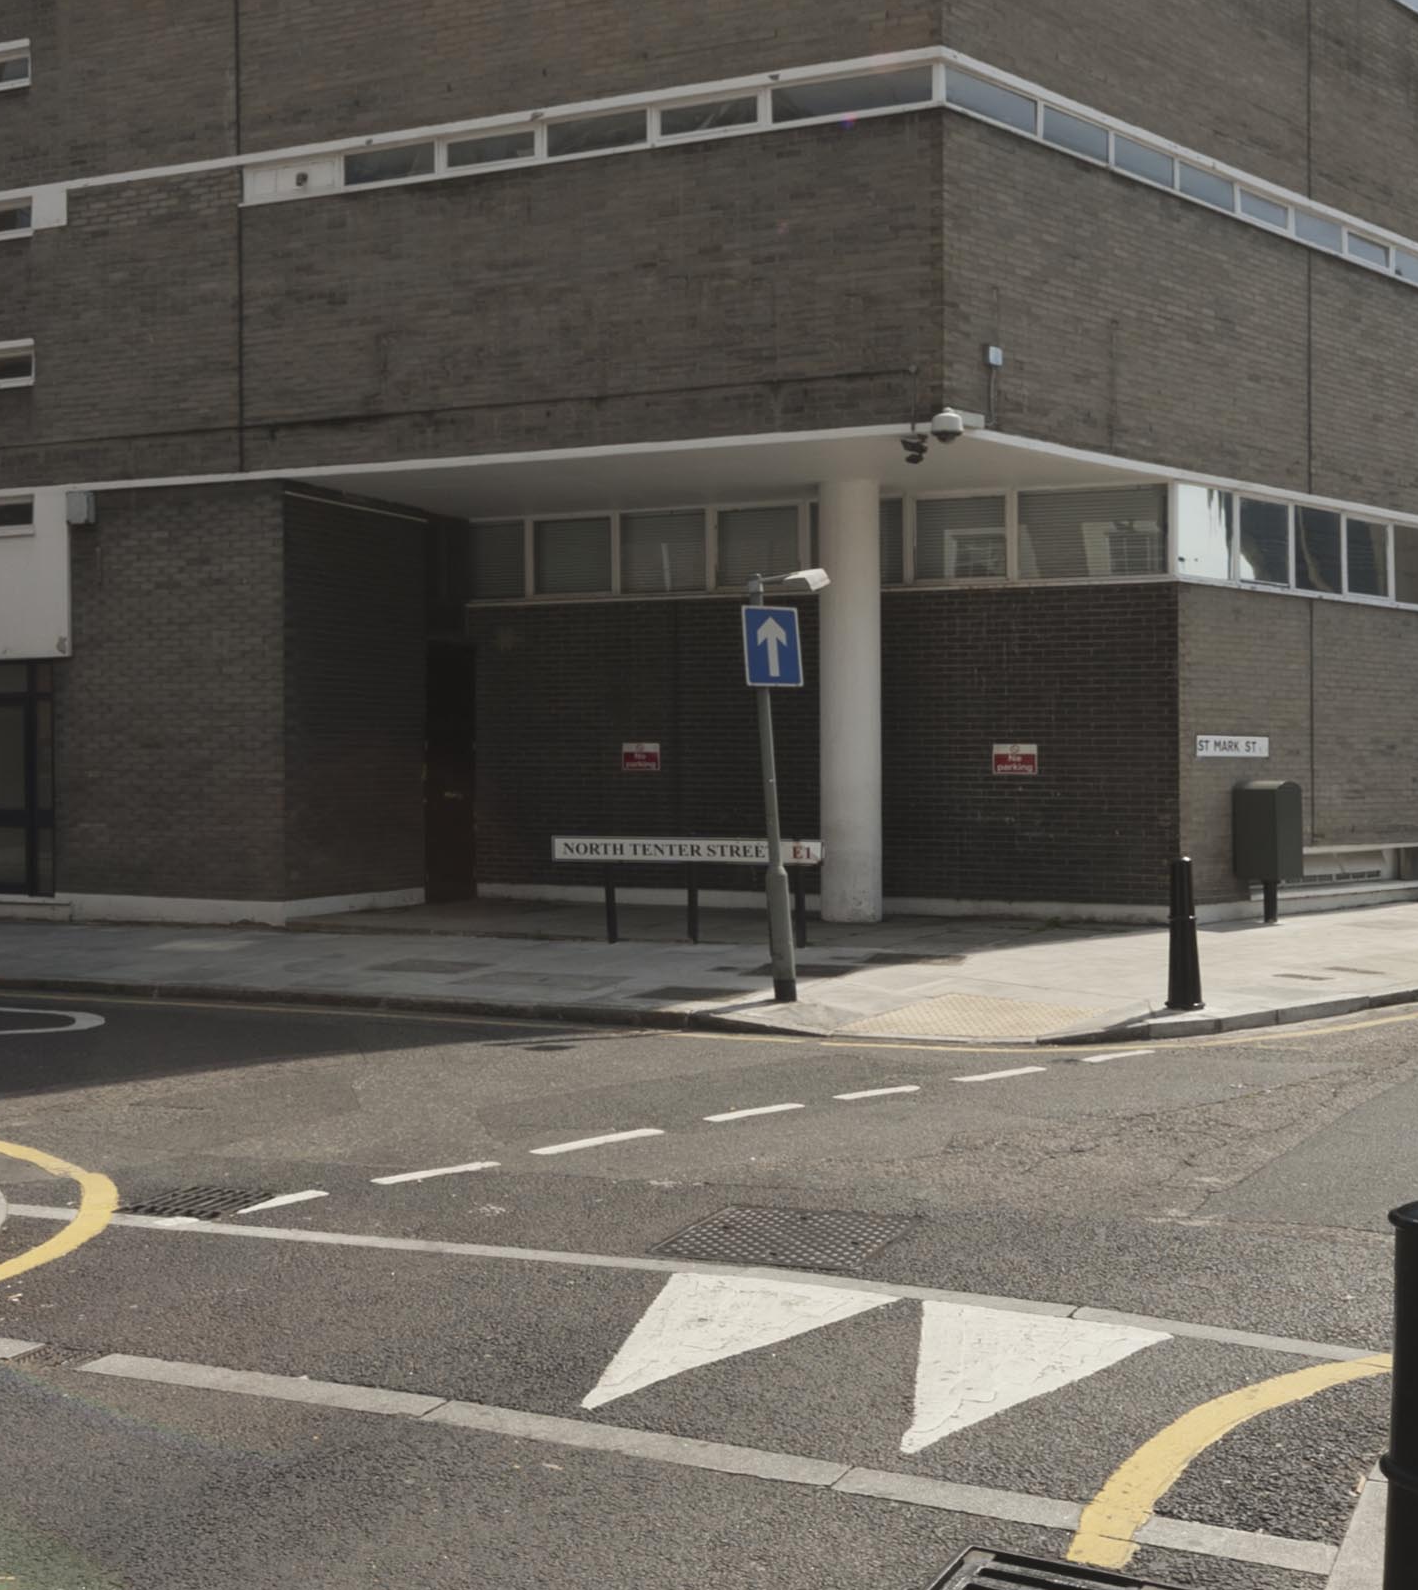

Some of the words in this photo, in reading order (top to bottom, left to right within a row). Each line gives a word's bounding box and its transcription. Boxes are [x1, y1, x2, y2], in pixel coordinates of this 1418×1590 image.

[1198, 739, 1210, 751] ST
[1213, 740, 1240, 753] MARK
[1244, 740, 1257, 753] ST
[563, 841, 625, 857] NORTH
[629, 842, 702, 858] TENTER
[792, 845, 812, 860] E1
